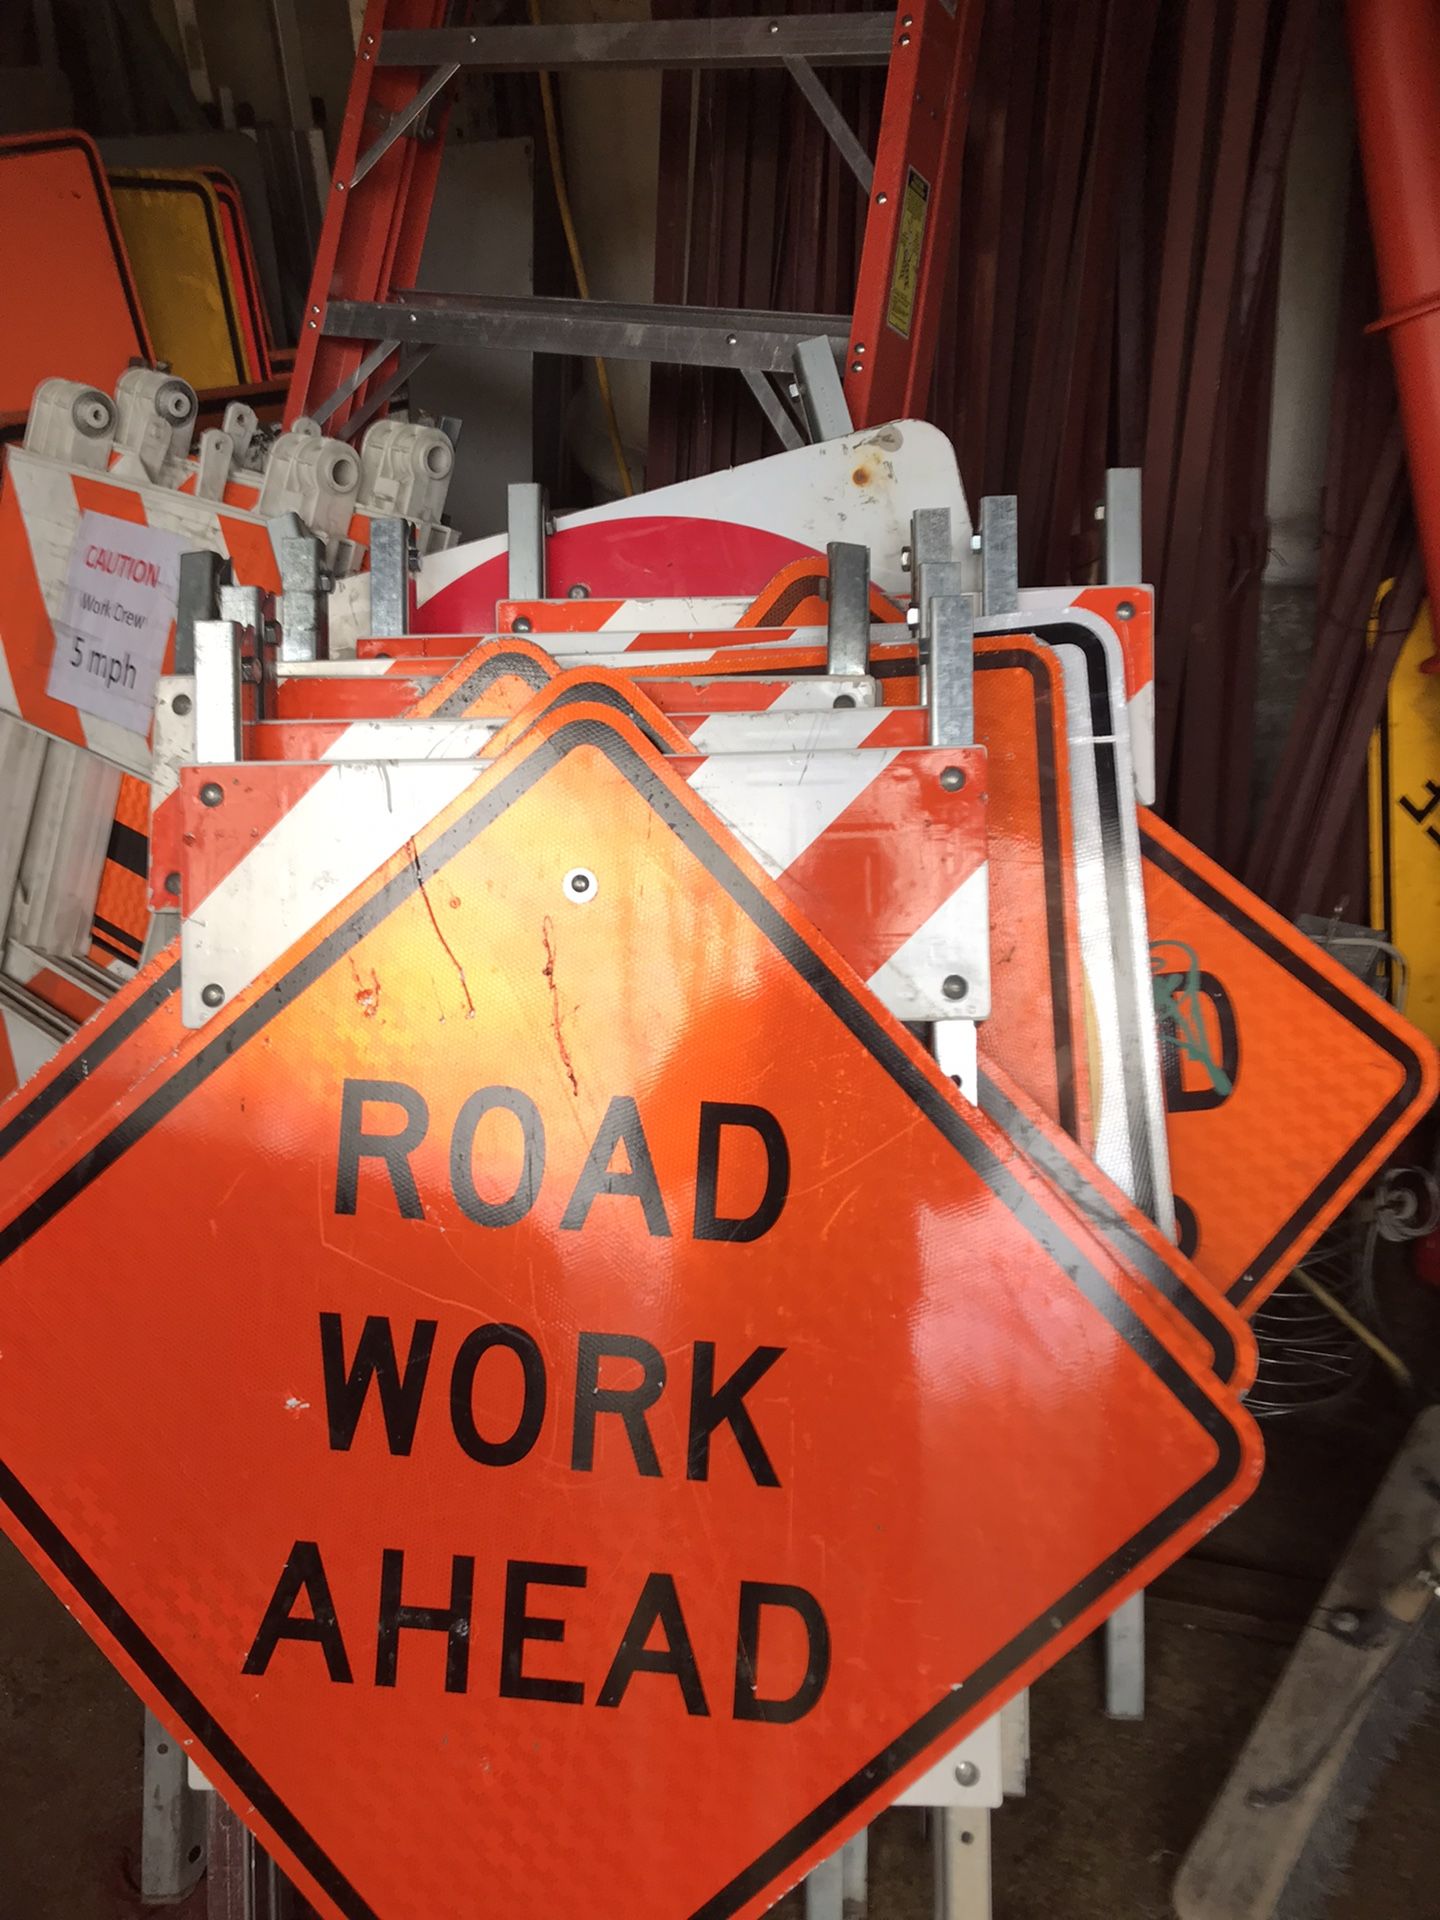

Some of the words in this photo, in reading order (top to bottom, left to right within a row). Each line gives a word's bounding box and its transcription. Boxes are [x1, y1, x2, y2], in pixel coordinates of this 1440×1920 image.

[80, 592, 111, 617] Work
[113, 599, 146, 630] Crew
[84, 545, 161, 588] CAUTION
[69, 636, 85, 668] 5
[87, 650, 137, 690] mph
[334, 1078, 791, 1243] ROAD
[319, 1312, 787, 1488] WORK
[241, 1540, 831, 1725] AHEAD
